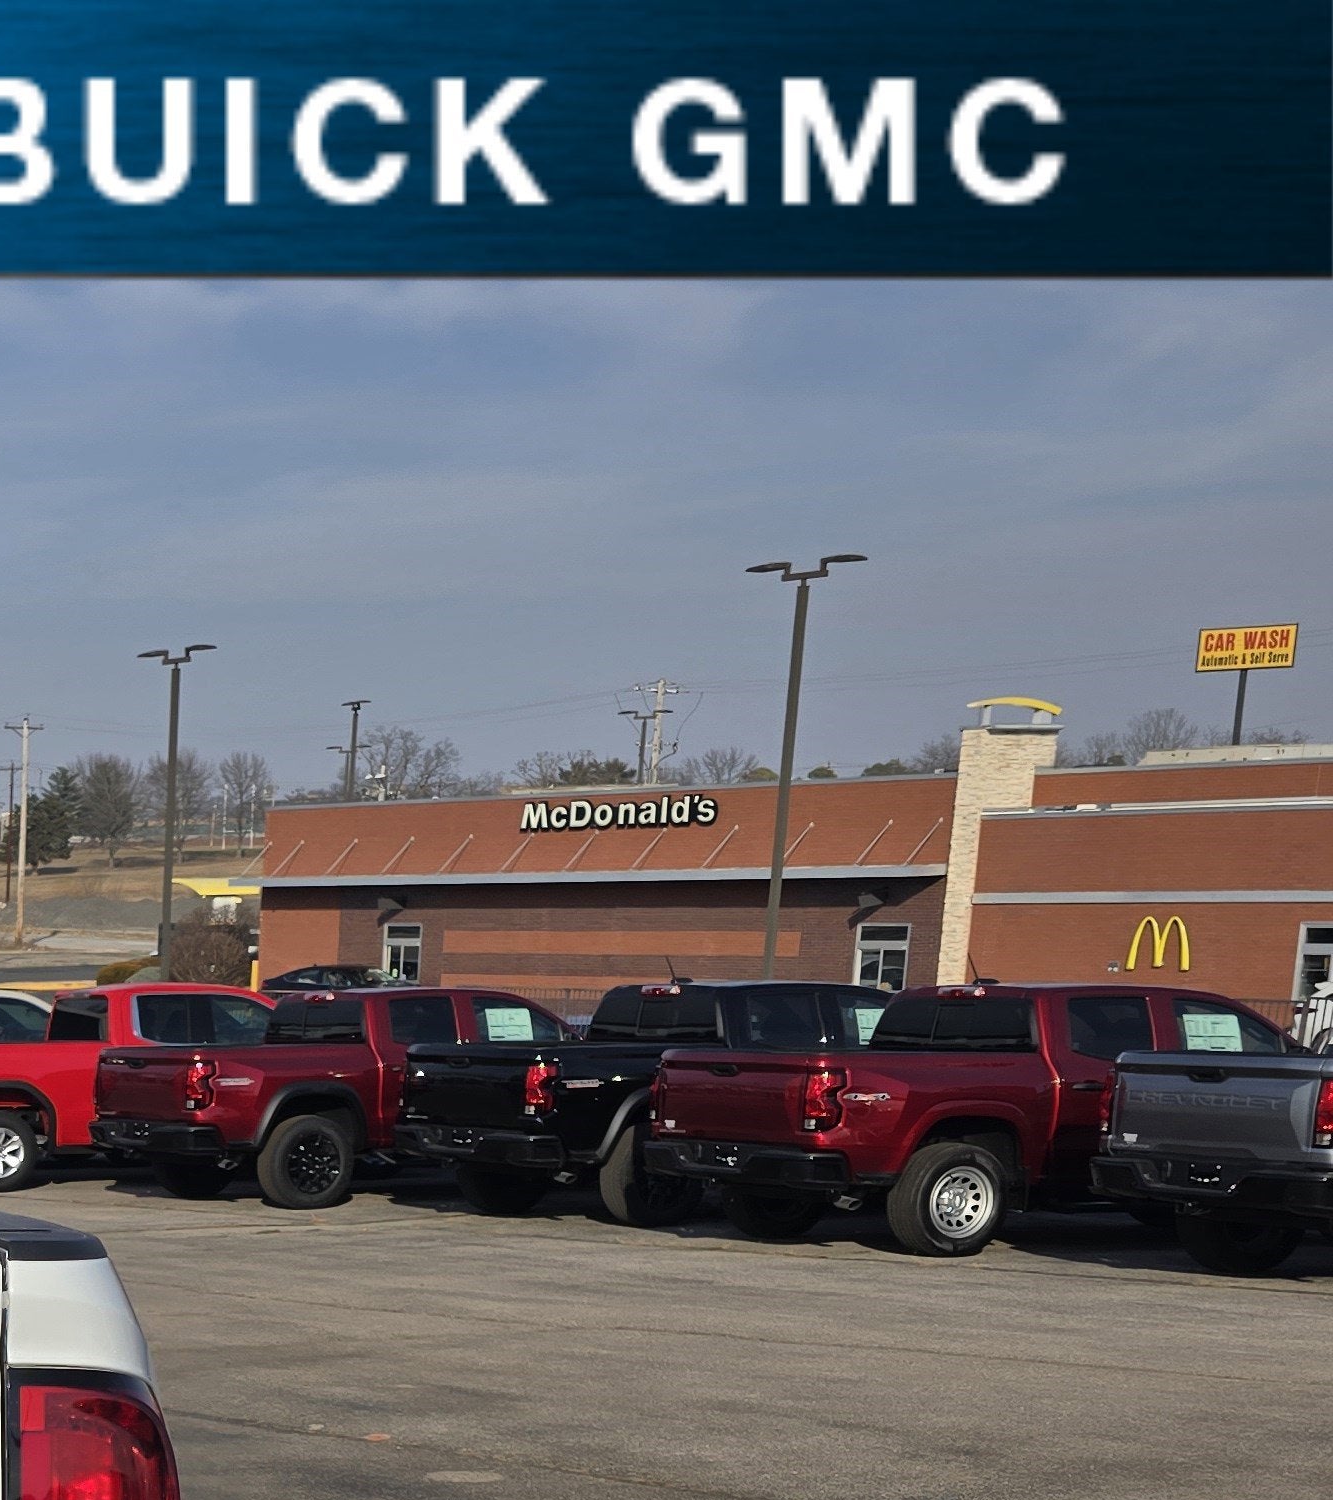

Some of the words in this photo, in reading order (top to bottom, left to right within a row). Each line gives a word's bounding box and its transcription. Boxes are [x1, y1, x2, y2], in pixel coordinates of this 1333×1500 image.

[1204, 632, 1236, 652] CAR
[1244, 629, 1290, 650] WASH
[1200, 653, 1239, 667] Automatic
[1249, 651, 1265, 664] Self
[1267, 650, 1289, 663] Serve
[519, 794, 718, 832] McDonald's
